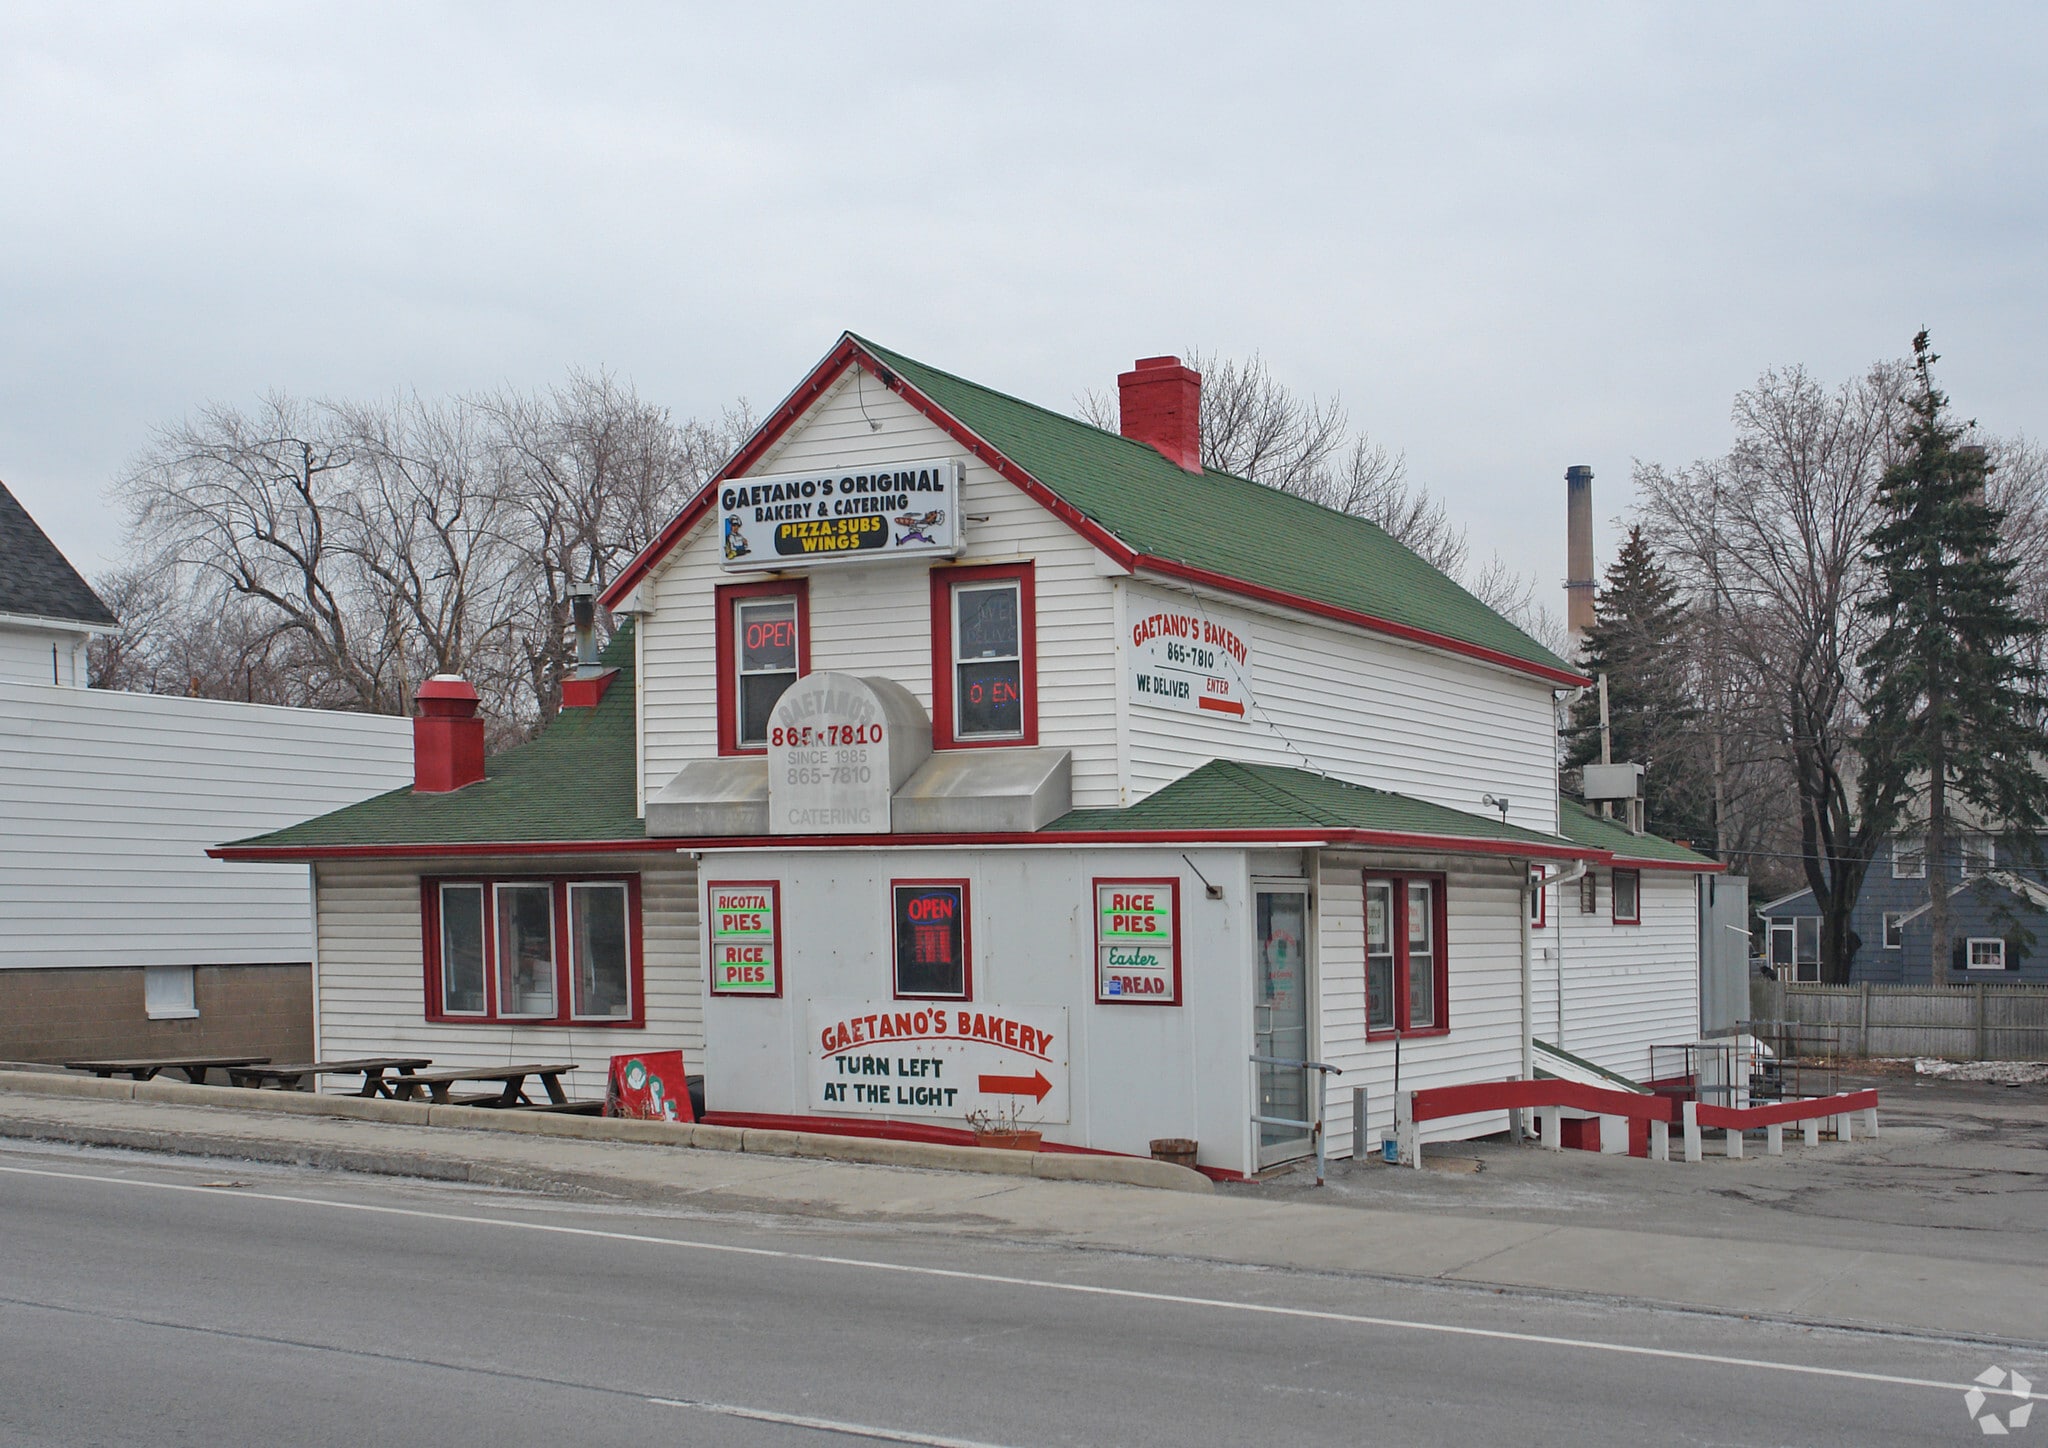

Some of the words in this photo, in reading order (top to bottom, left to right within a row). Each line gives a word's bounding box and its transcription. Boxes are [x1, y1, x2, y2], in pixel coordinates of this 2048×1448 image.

[722, 479, 833, 511] GAETANO'S
[840, 469, 944, 494] ORIGINAL
[755, 501, 811, 523] BAKERY
[818, 502, 828, 517] &
[834, 494, 908, 516] CATERING
[801, 534, 860, 553] WINGS
[1133, 613, 1199, 647] GAETANO'S
[1204, 620, 1247, 667] BAKERY
[1167, 642, 1214, 669] 865-7810
[969, 682, 1018, 704] OEN
[1137, 673, 1151, 693] WE
[1153, 676, 1190, 699] DELIVER
[1206, 678, 1229, 695] ENTER
[787, 751, 828, 765] SINCE
[835, 750, 867, 764] 1985
[787, 766, 871, 785] 865-7810
[788, 807, 871, 826] CATERING
[718, 895, 766, 910] RICOTTA
[908, 898, 953, 920] OPEN
[1112, 893, 1155, 912] RICE
[722, 914, 762, 931] PIES
[1113, 915, 1156, 933] PIES
[725, 947, 763, 963] RICE
[1109, 946, 1158, 967] Easter
[726, 966, 765, 983] PIES
[821, 1007, 947, 1051] GAETANO'S
[957, 1011, 1054, 1055] BAKERY
[835, 1055, 890, 1076] TURN
[897, 1057, 943, 1078] LEFT
[624, 1058, 682, 1123] OPE
[824, 1082, 848, 1102] AT
[853, 1083, 890, 1104] THE
[897, 1086, 958, 1107] LIGHT
